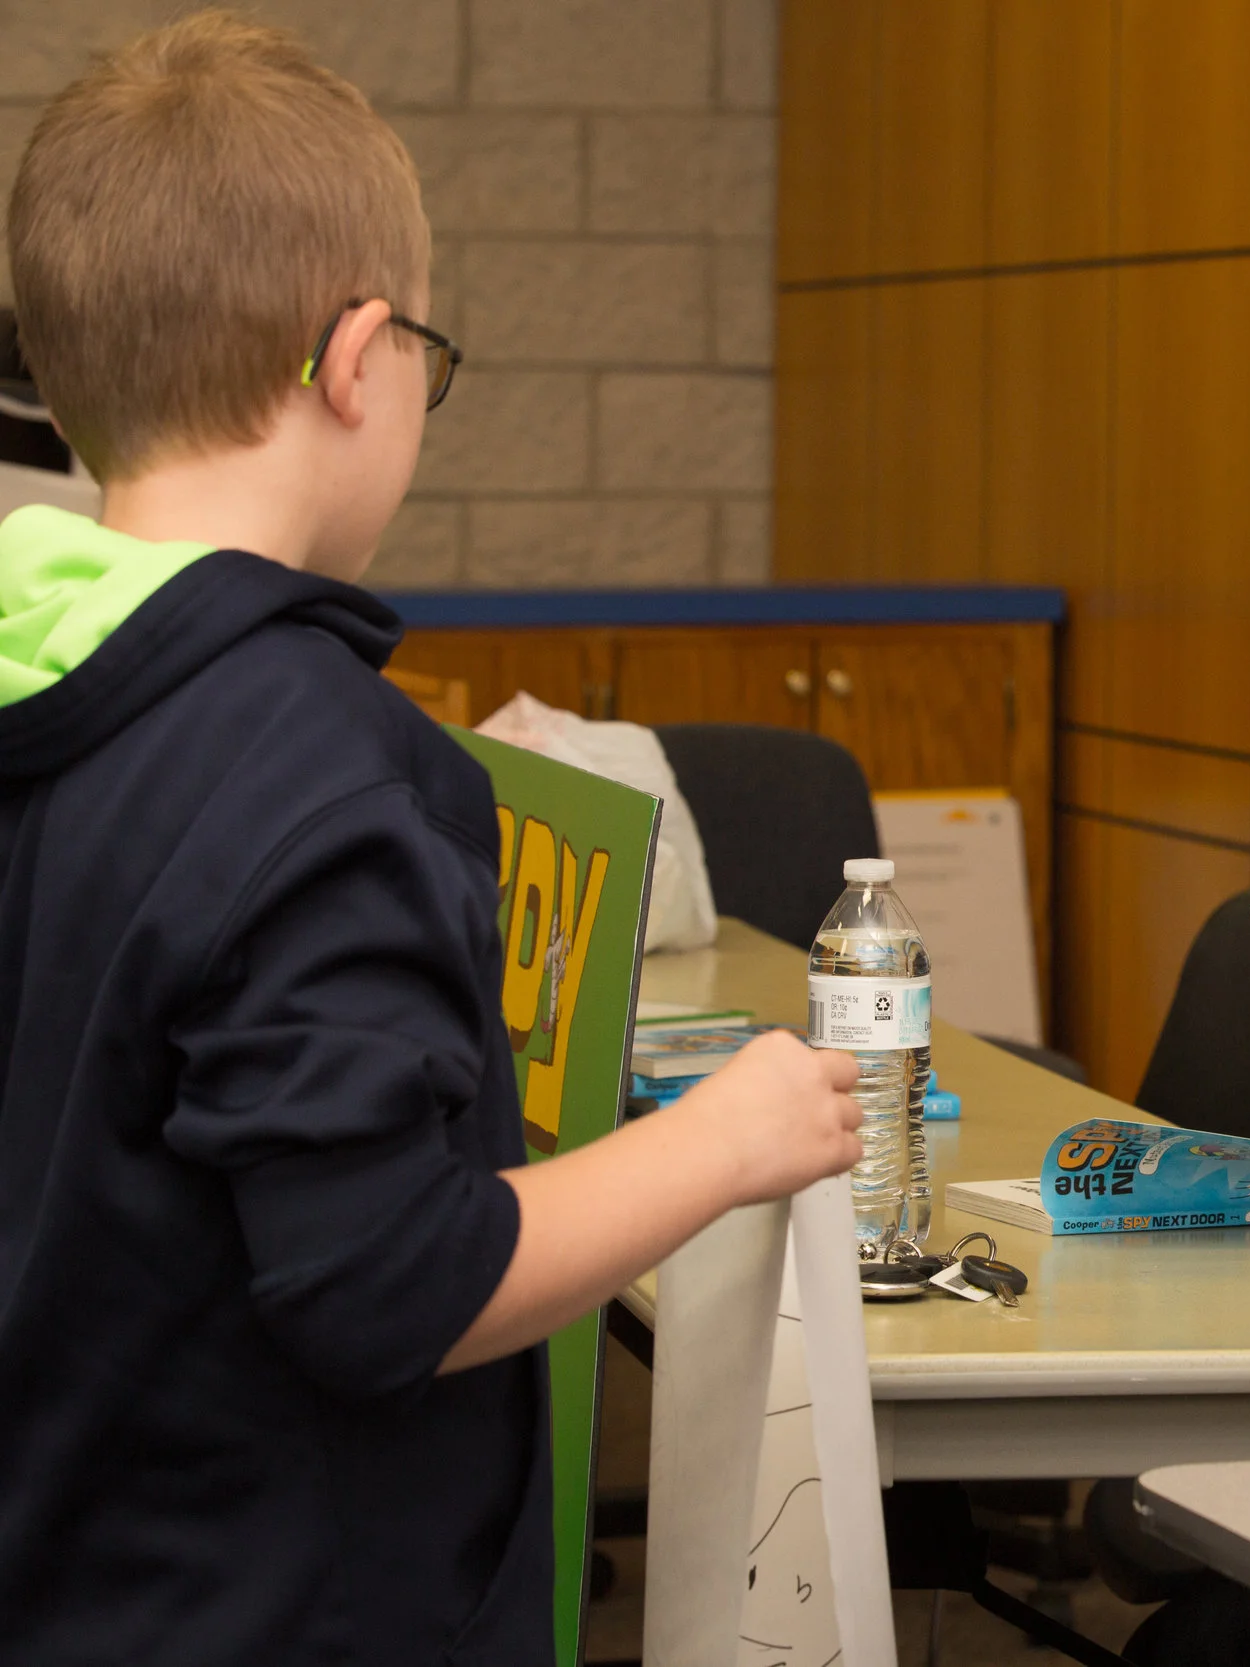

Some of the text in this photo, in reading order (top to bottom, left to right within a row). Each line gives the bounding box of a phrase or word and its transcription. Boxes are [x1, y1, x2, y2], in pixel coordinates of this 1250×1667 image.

[1055, 1174, 1107, 1200] the
[1063, 1220, 1099, 1231] Cooper
[1123, 1215, 1152, 1230] SPY
[1152, 1215, 1187, 1228] NEXT
[1190, 1213, 1225, 1225] DOOR
